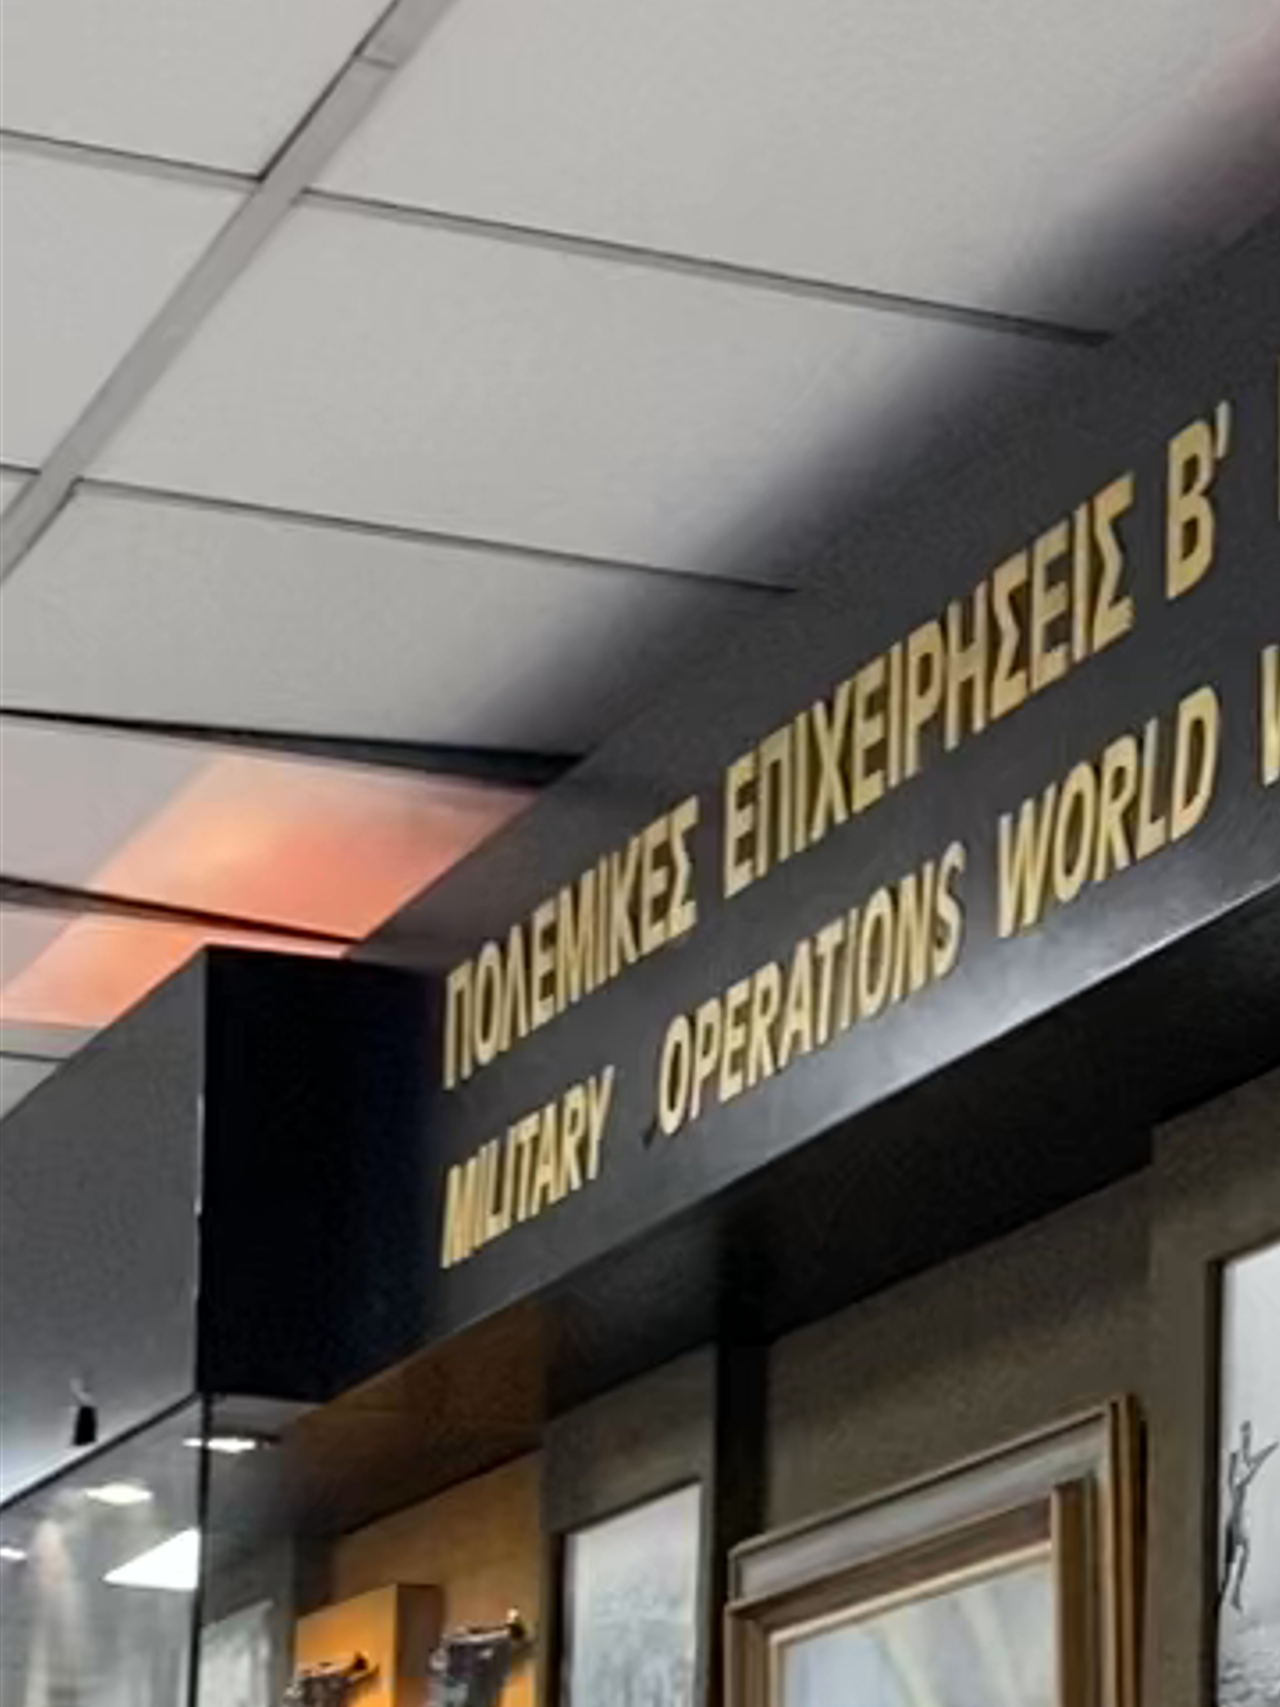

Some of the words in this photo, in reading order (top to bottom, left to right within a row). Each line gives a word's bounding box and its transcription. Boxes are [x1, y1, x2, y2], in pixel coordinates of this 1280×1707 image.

[441, 1066, 613, 1268] MILITARY
[656, 842, 967, 1136] OPERATIONS
[995, 687, 1220, 938] WORLD
[445, 796, 700, 1089] ΠΟΛΕΜΙΚΕΣ
[723, 473, 1134, 897] ΕΠΙΧΕΙΡΗΣΕΙΣ
